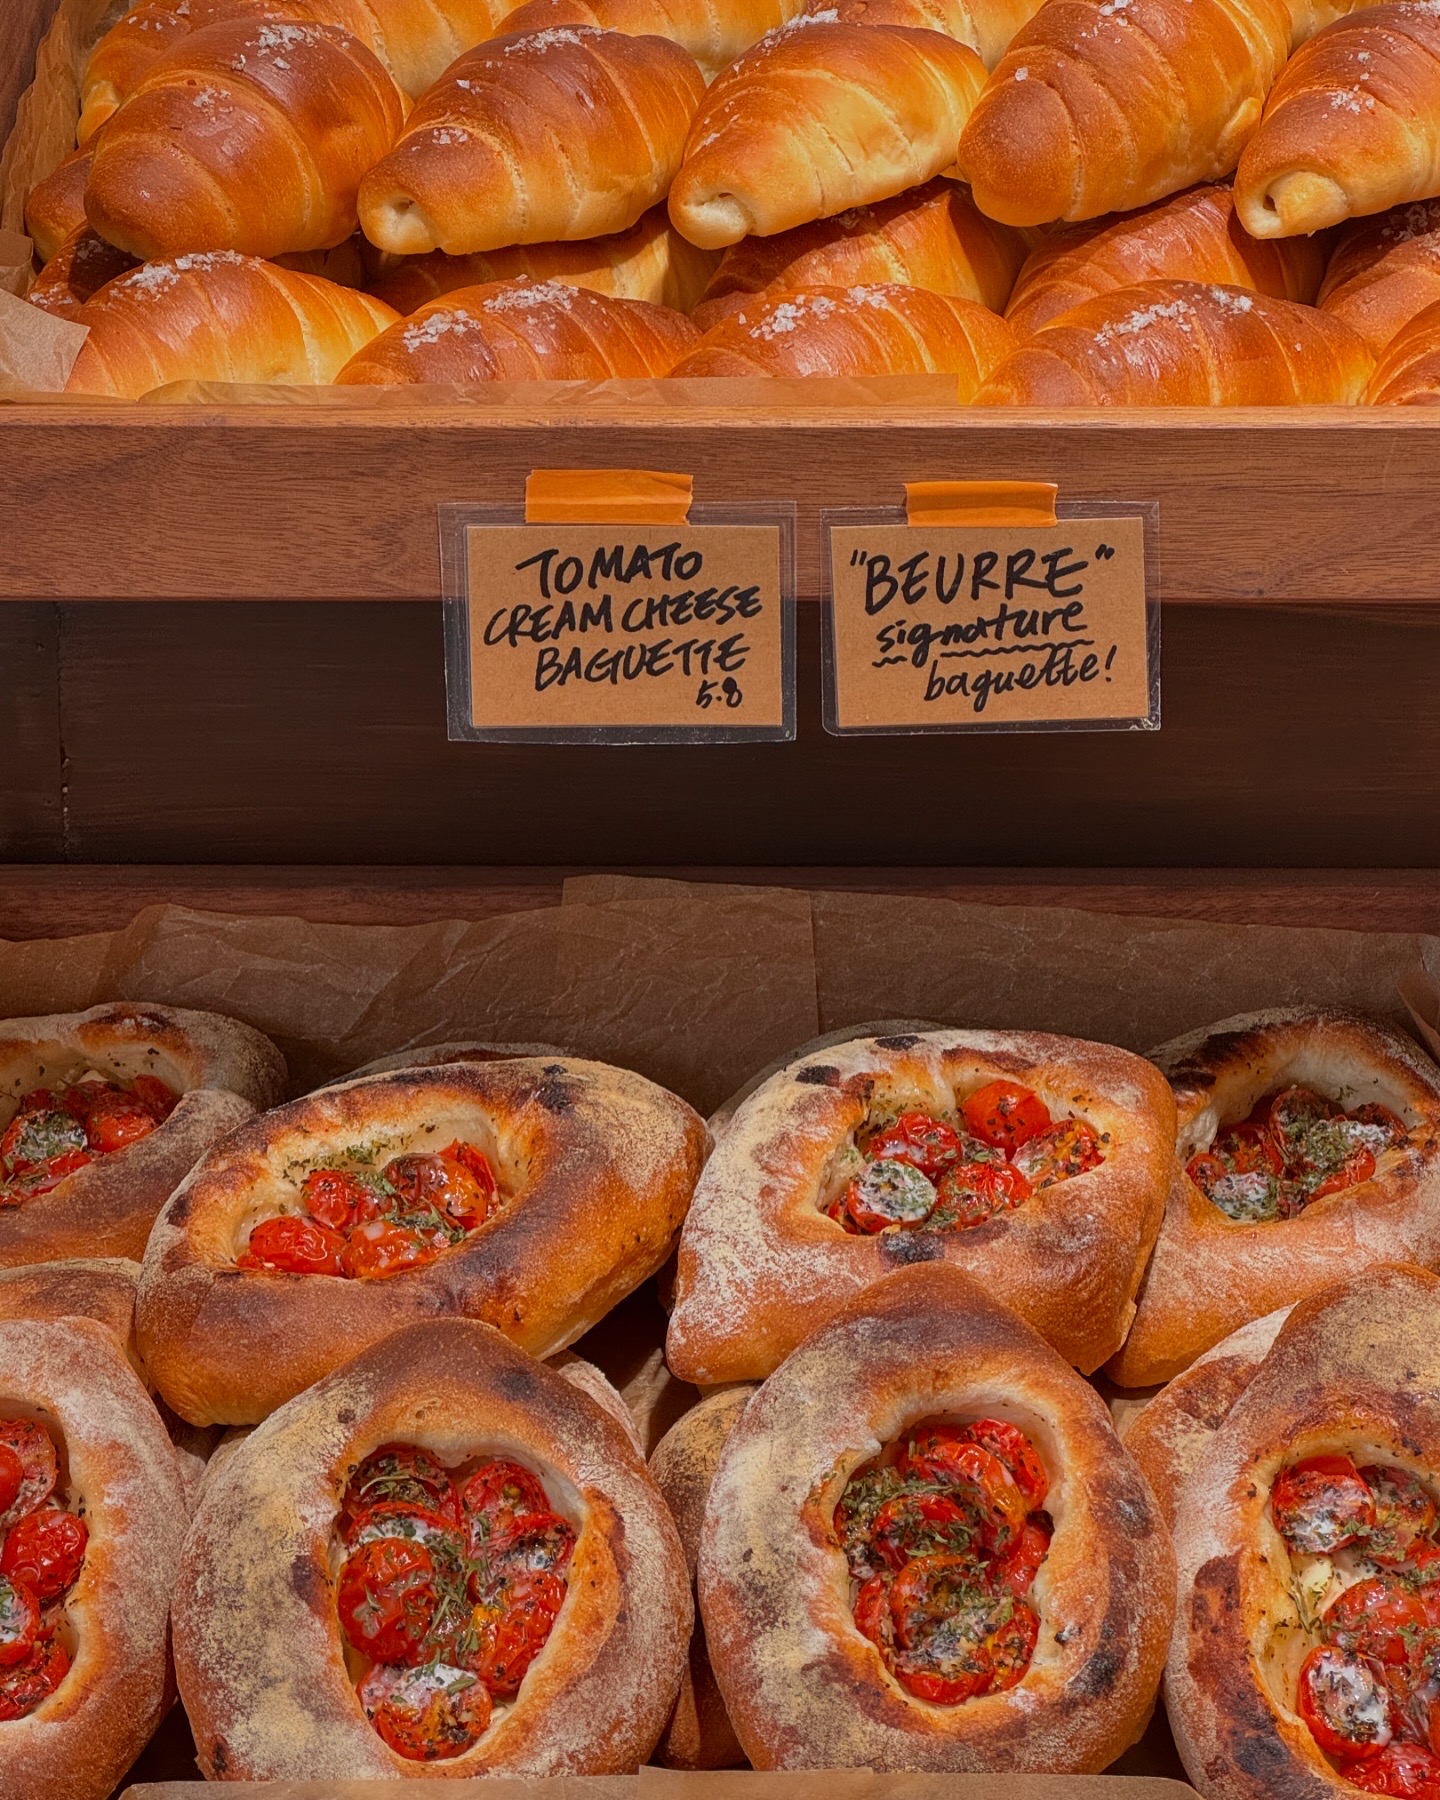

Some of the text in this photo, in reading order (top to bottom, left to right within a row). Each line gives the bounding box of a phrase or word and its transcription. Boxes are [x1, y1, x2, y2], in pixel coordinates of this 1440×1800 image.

[515, 542, 703, 598] TOMATO
[483, 585, 763, 647] CREAM CHEESE
[876, 601, 1088, 668] signature
[534, 633, 751, 691] BAGUETTE
[924, 645, 1117, 712] baguette!
